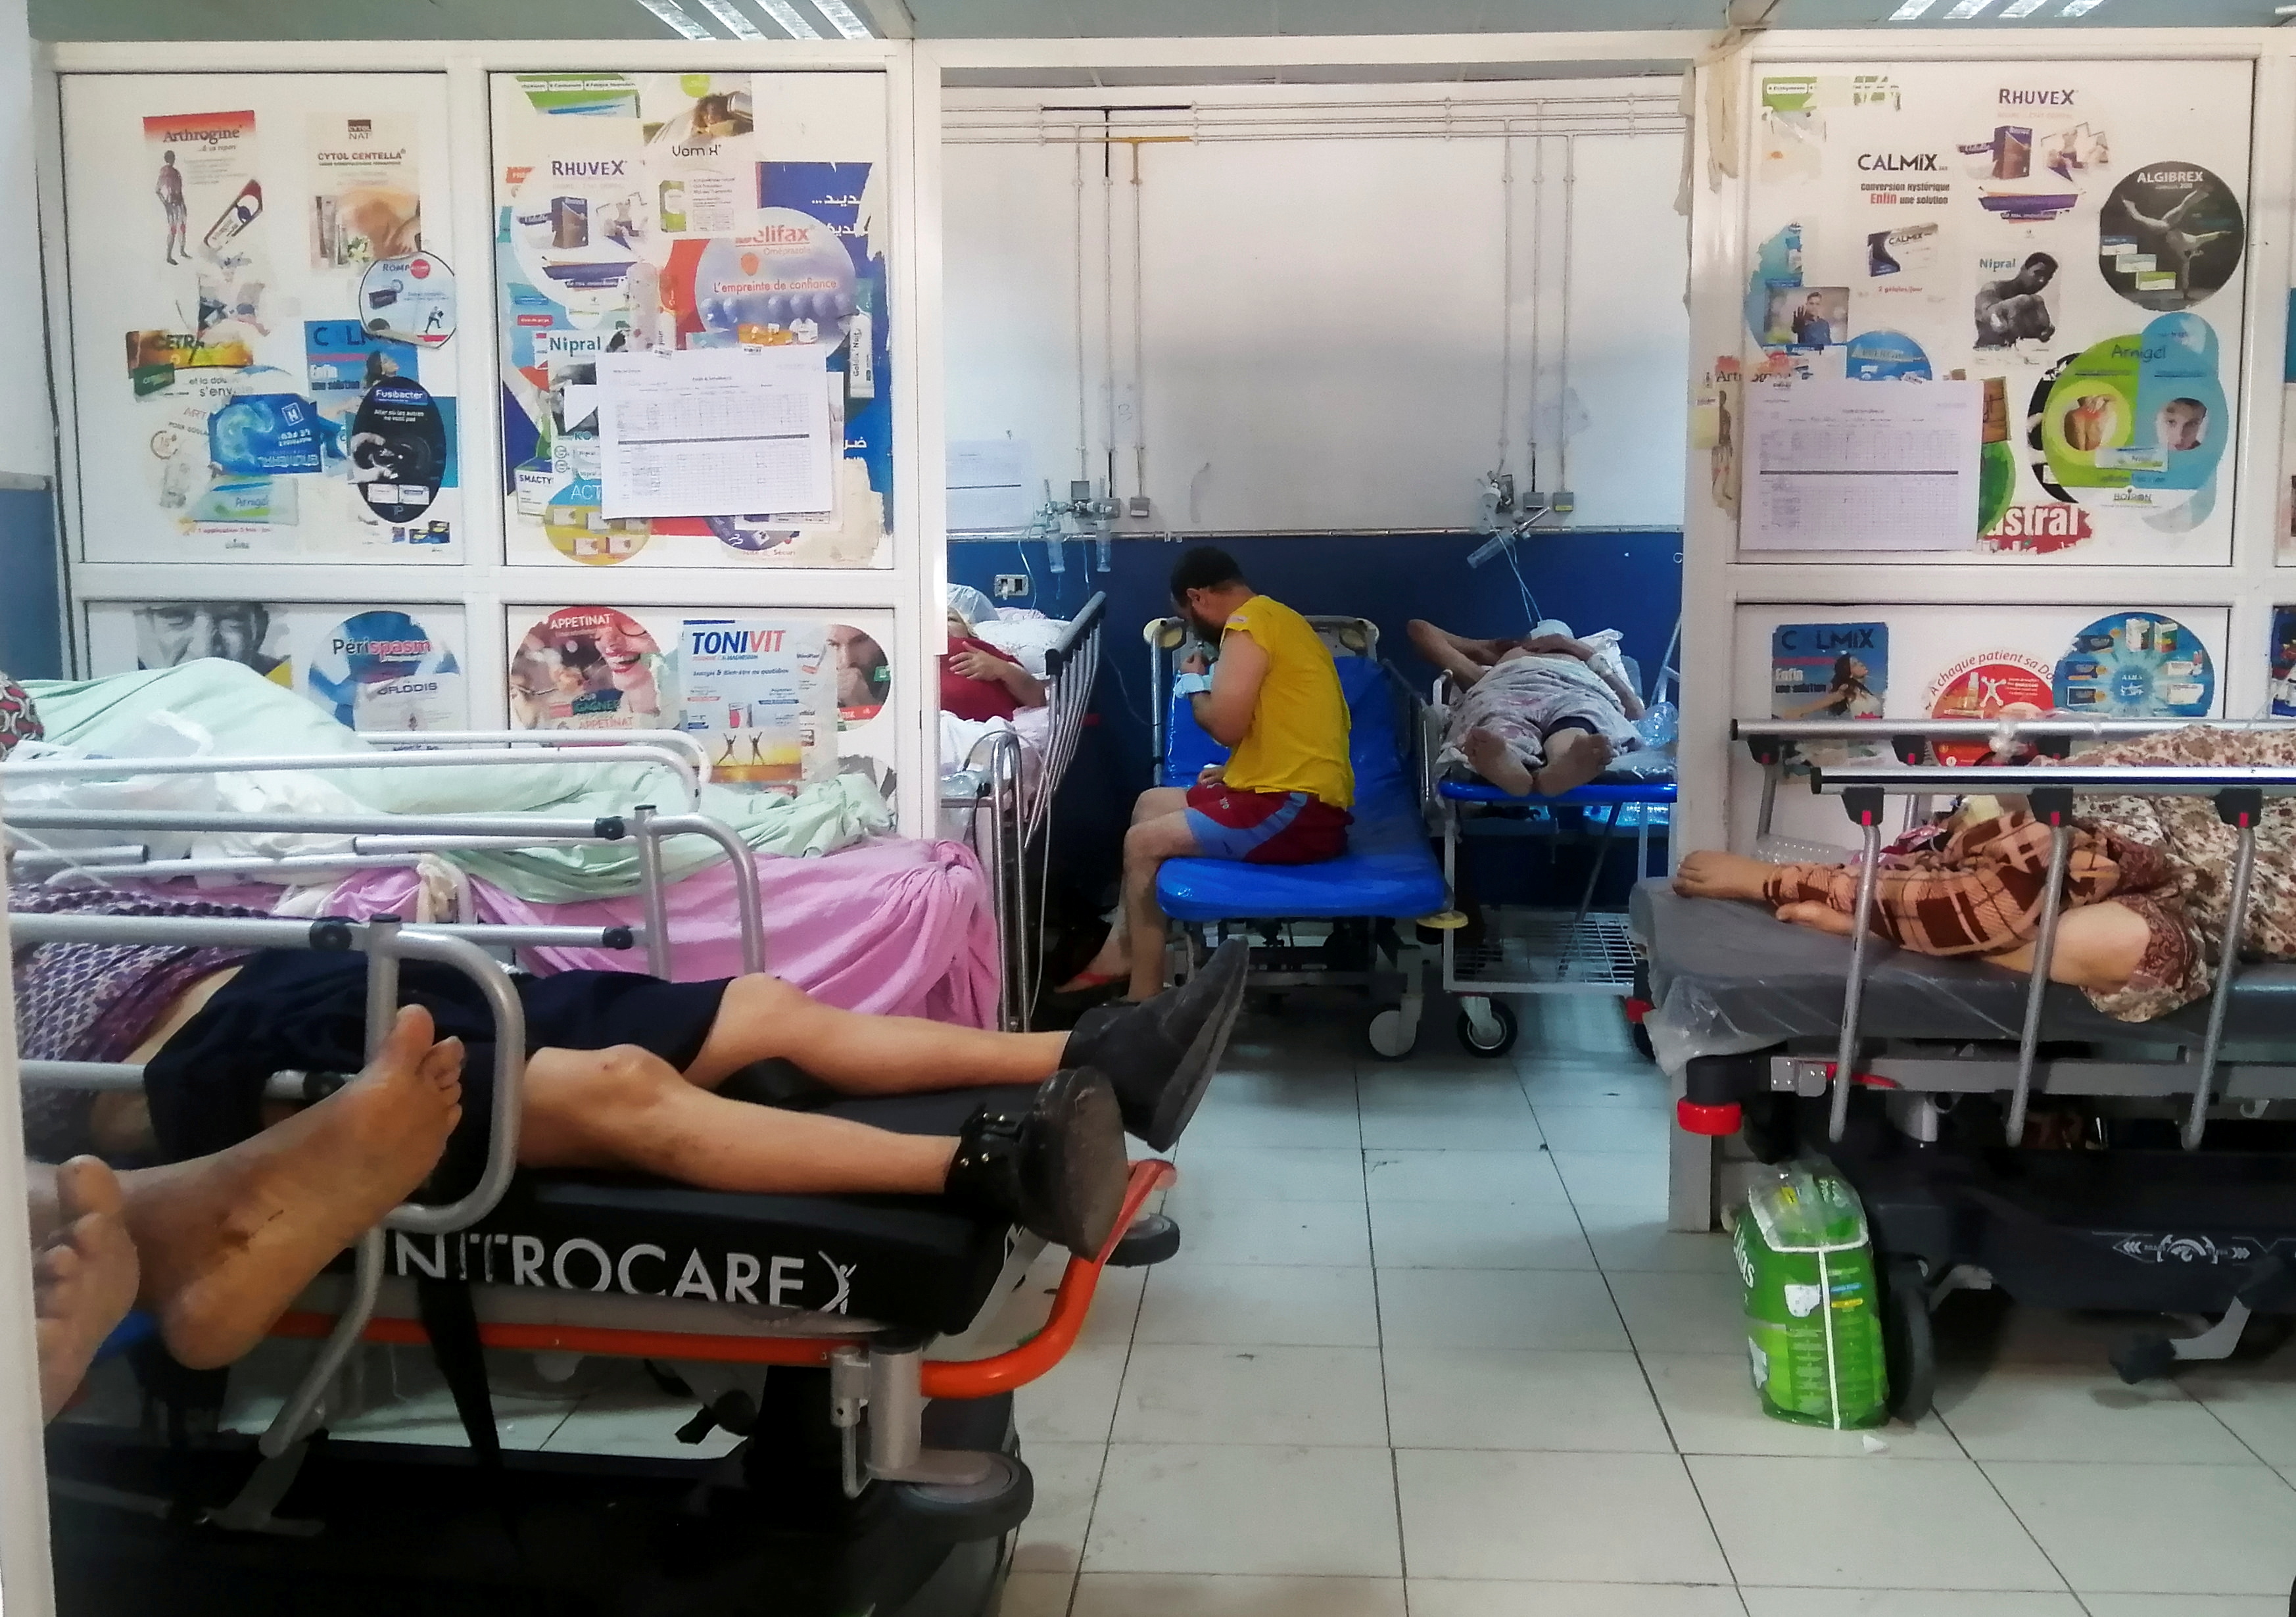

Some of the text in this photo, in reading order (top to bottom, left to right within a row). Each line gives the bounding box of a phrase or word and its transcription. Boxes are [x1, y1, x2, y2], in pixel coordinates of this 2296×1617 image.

[1999, 88, 2074, 105] RHUVEX
[164, 129, 240, 145] Arthrogine
[552, 160, 625, 176] RHUVEX
[2137, 172, 2203, 183] ALGIBREX
[1979, 258, 2016, 272] Nipral
[714, 278, 837, 295] L'empreinte de confiance
[550, 337, 601, 357] Nipral
[550, 614, 611, 629] APPETINAT
[333, 637, 432, 658] Périspasm
[692, 629, 786, 655] TONIVIT
[1978, 649, 2024, 665] patient
[2025, 658, 2038, 669] sa
